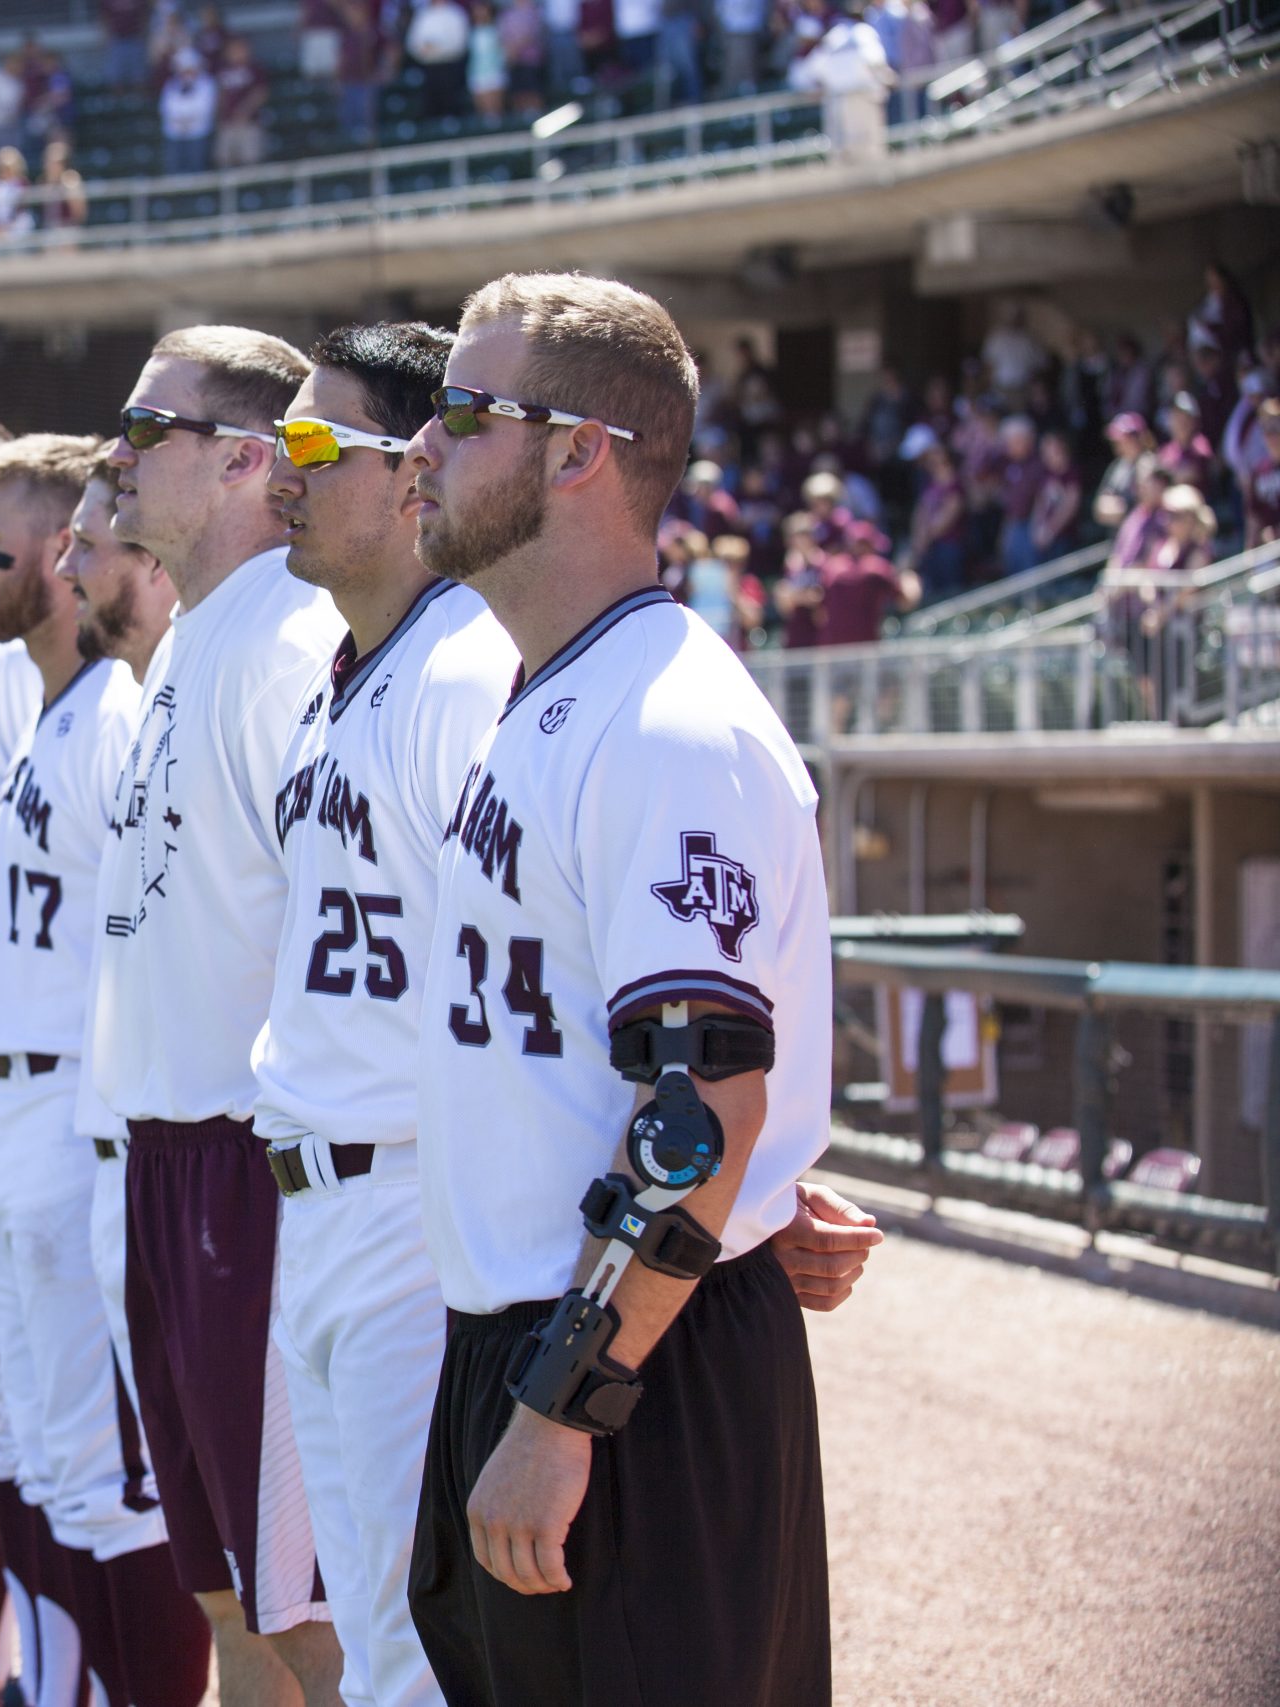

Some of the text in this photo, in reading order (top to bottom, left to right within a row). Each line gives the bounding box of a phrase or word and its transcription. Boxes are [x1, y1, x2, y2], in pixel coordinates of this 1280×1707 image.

[7, 863, 63, 950] 17
[305, 886, 409, 1002] 25
[447, 923, 564, 1059] 34
